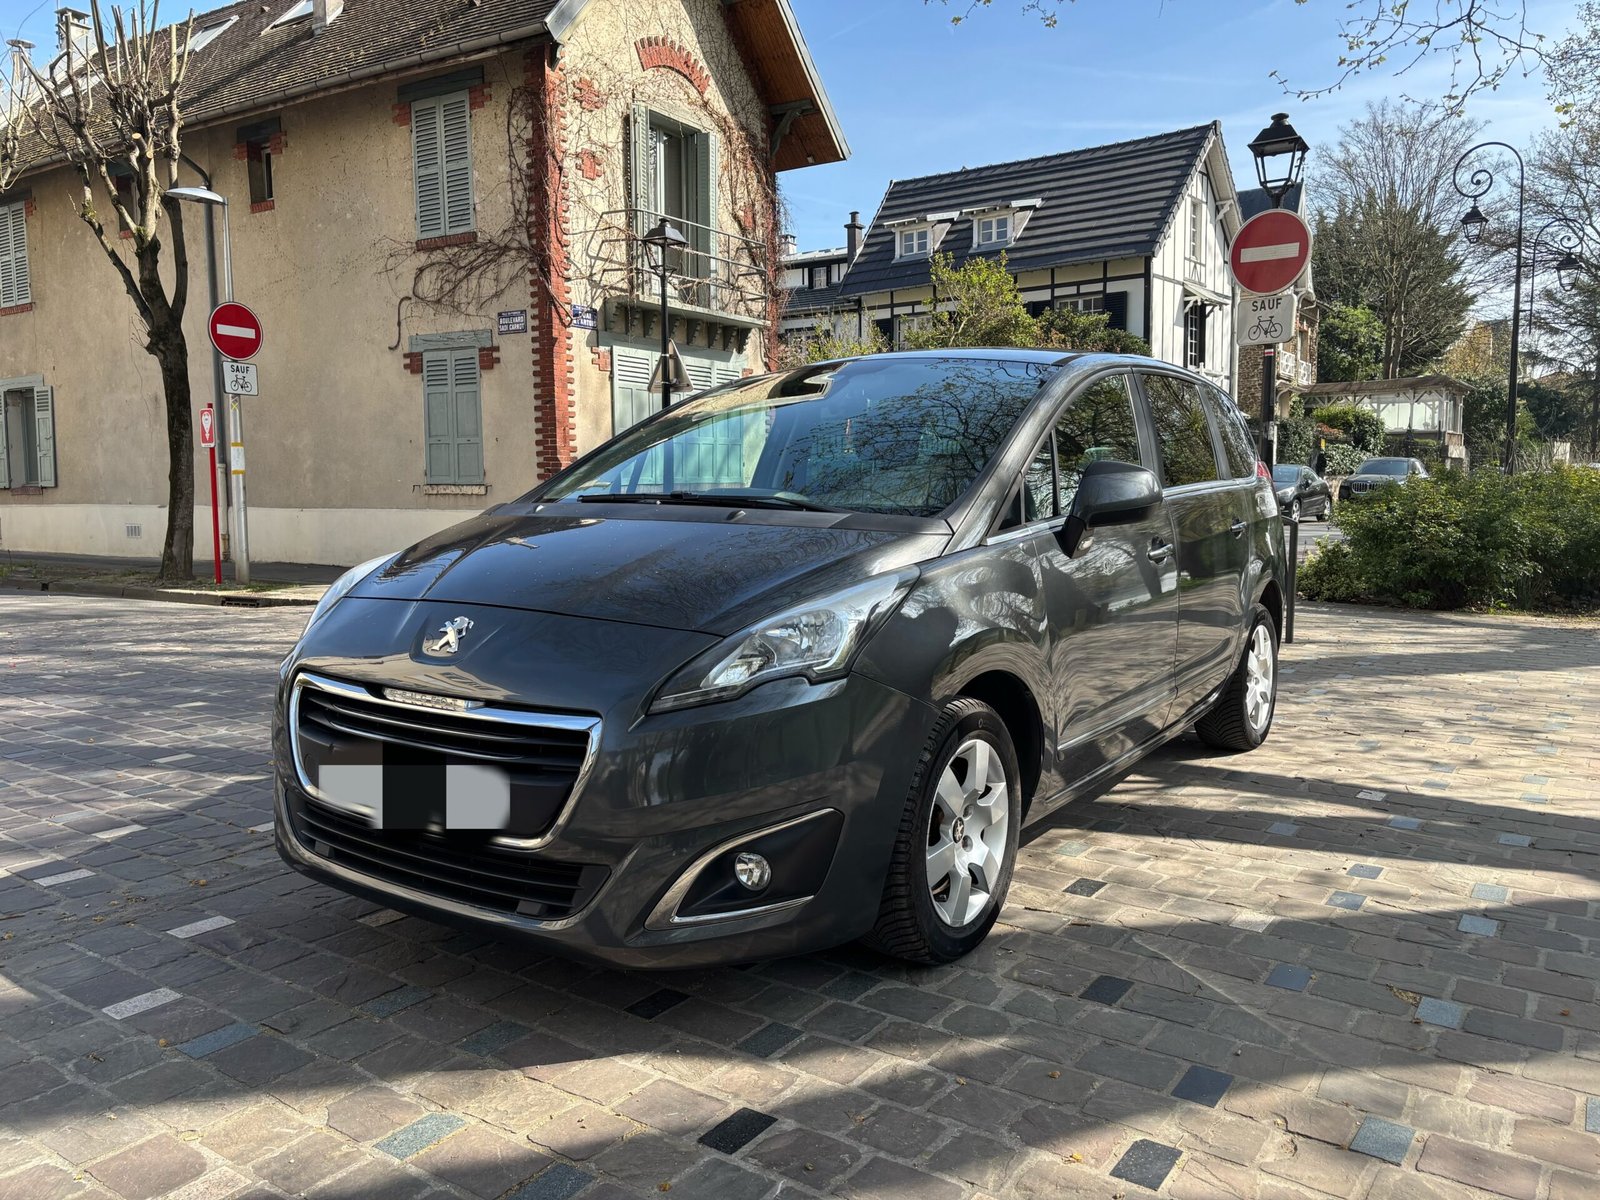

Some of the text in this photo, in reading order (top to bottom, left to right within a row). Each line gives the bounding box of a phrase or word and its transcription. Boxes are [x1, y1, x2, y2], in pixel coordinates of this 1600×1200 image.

[1251, 298, 1282, 312] SAUF
[499, 316, 524, 324] BOULEVARD
[230, 364, 250, 374] SAUF
[389, 688, 459, 708] PEUGEOT
